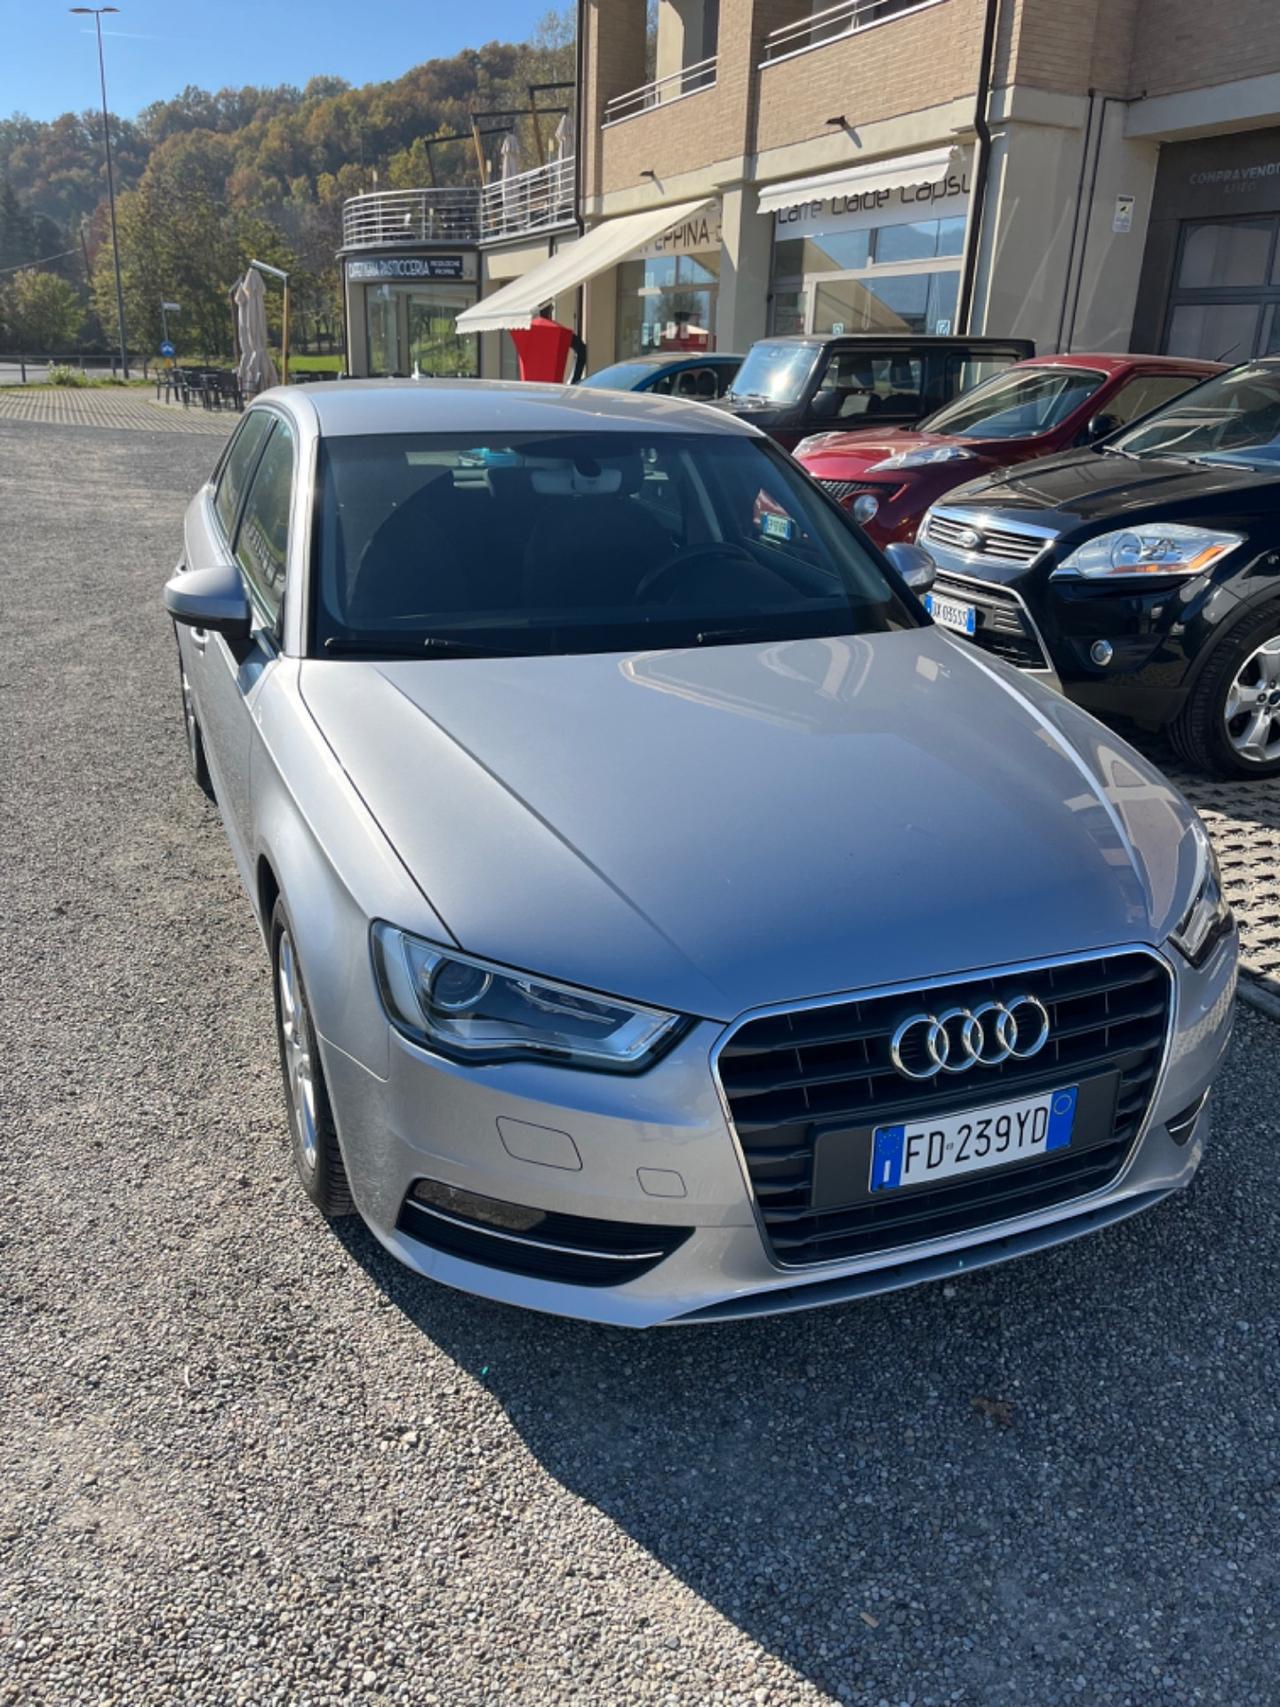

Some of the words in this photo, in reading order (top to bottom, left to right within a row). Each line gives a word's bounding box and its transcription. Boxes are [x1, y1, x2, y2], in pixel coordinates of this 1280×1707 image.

[644, 217, 710, 252] EPPINA
[904, 1130, 946, 1174] FD
[955, 1106, 1049, 1164] 239YD
